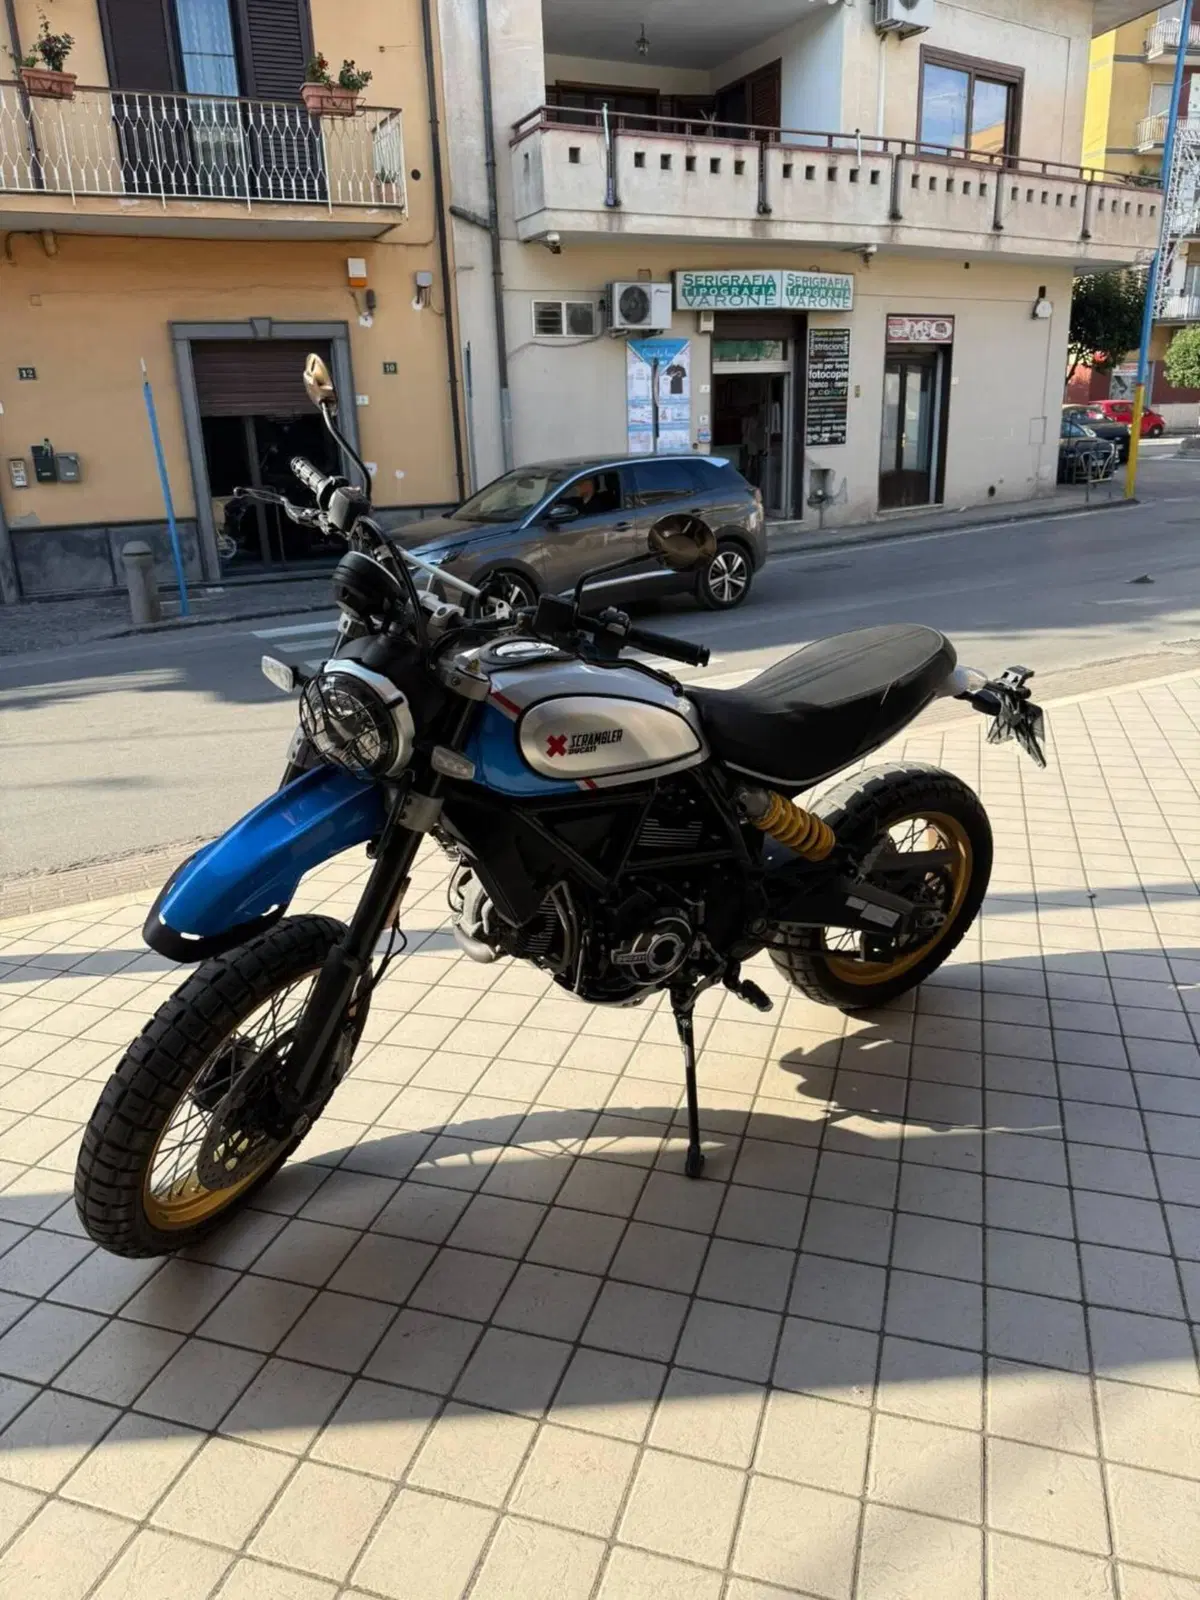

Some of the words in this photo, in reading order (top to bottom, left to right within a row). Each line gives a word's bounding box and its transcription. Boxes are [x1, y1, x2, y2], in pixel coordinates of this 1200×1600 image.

[683, 273, 776, 287] SERIGRAFIA
[786, 273, 851, 288] SERIGRAFIA
[683, 286, 776, 297] TIPOGRAFIA
[787, 287, 850, 299] TIPOGRAFIA
[683, 295, 776, 307] VARONE
[786, 296, 850, 308] VARONE
[21, 368, 33, 378] 12
[808, 370, 848, 381] fotocopie
[569, 728, 623, 748] SCRAMBLER
[567, 745, 597, 756] DUCATI
